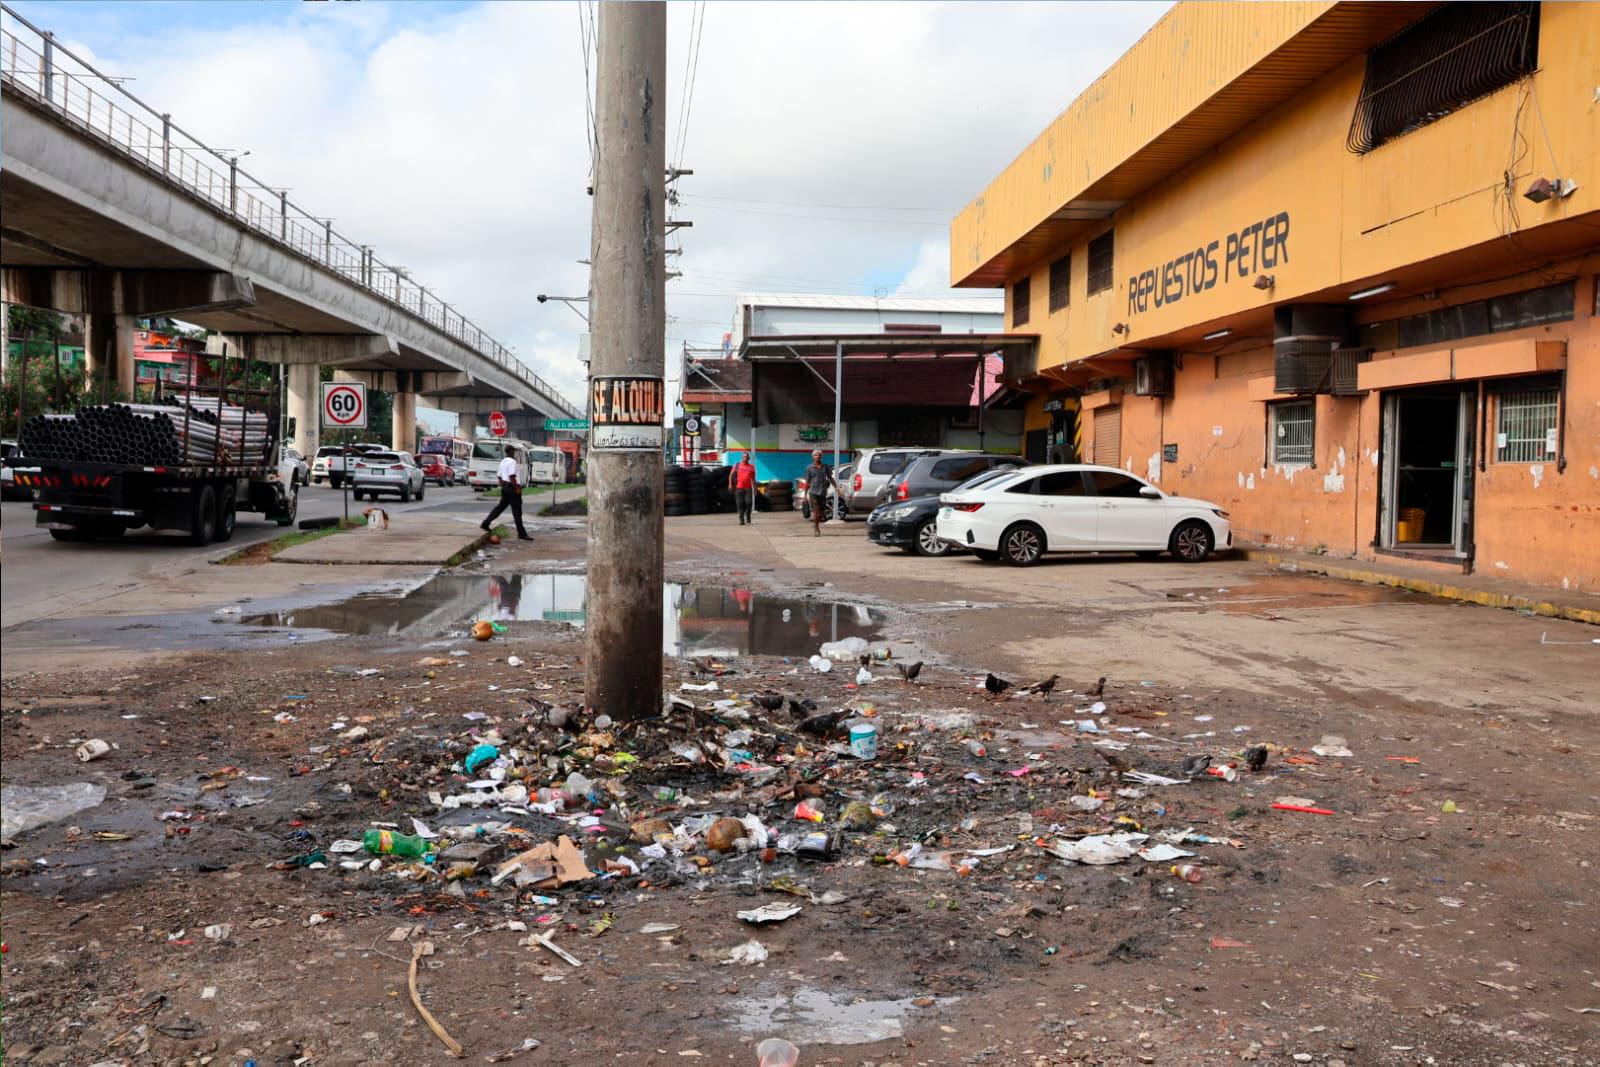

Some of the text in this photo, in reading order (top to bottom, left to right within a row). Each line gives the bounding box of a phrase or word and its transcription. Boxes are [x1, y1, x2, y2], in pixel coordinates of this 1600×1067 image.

[1128, 211, 1290, 317] REPUESTOS PETER
[332, 394, 355, 412] 60
[593, 380, 663, 424] SE ALQUILA
[490, 418, 506, 429] ALTO
